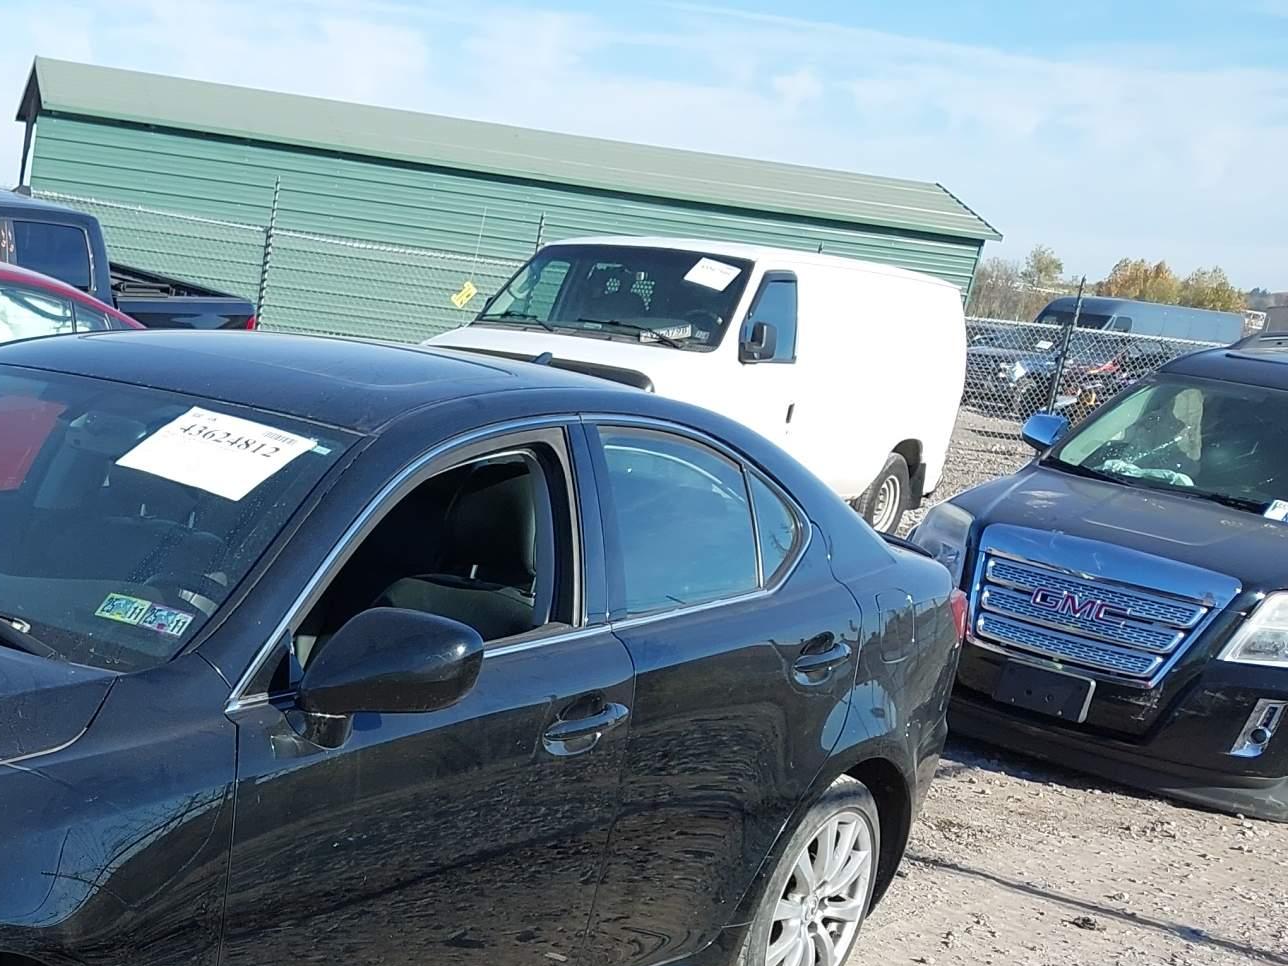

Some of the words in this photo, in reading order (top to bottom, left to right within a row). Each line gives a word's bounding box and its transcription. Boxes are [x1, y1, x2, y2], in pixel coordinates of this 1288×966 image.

[179, 423, 280, 458] 43624812
[128, 607, 144, 620] 11
[1031, 586, 1132, 628] GMC
[170, 618, 186, 634] 11
